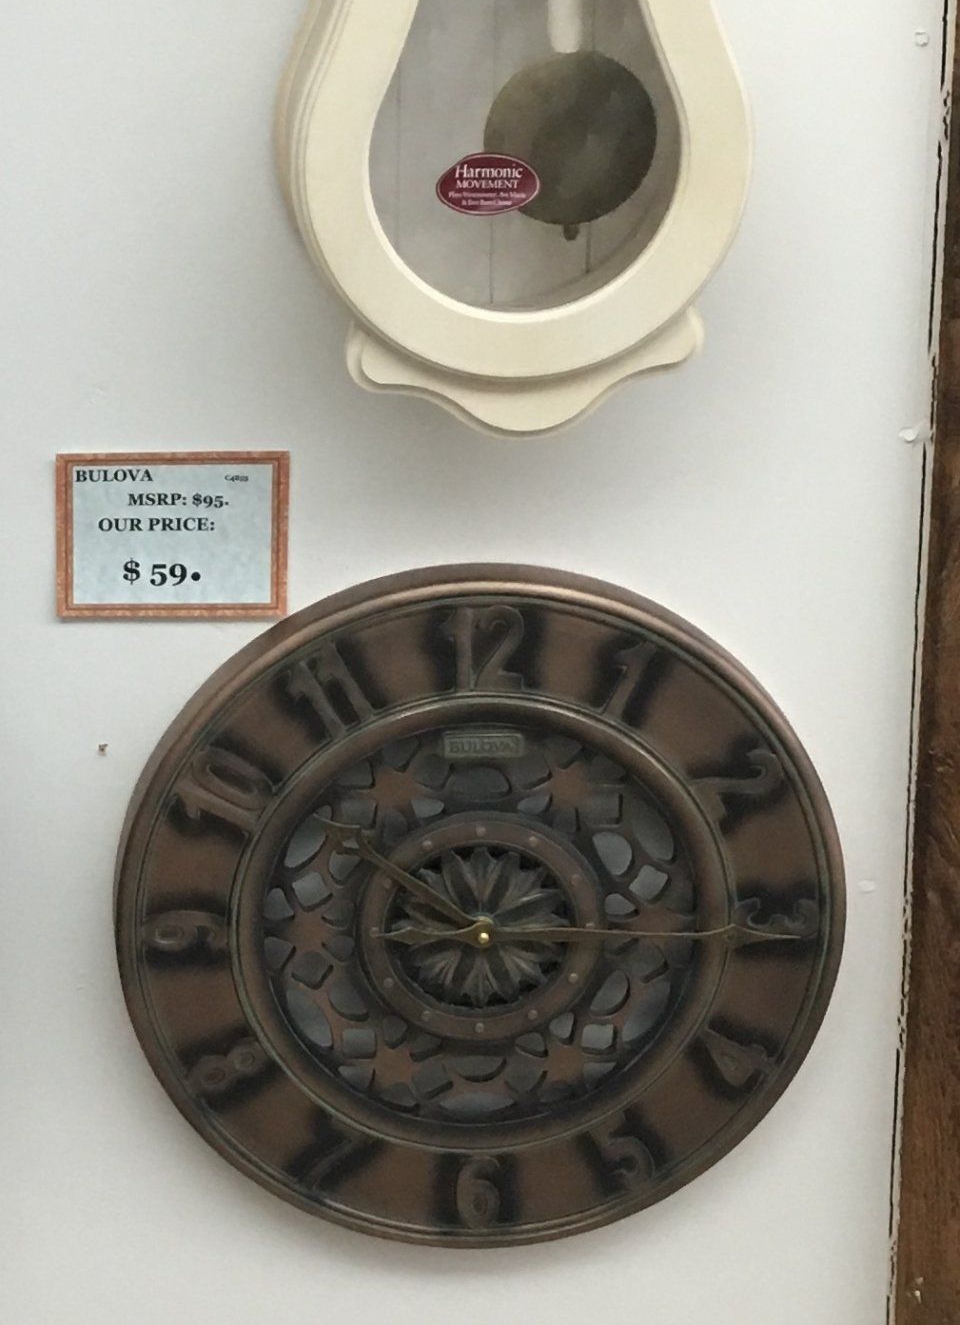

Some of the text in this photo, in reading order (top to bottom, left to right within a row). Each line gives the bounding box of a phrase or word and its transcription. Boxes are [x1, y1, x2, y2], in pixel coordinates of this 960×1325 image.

[455, 163, 523, 178] Harmonic
[456, 179, 519, 189] MOVEMENT
[75, 468, 153, 482] BULOVA
[128, 492, 229, 509] MSRP: $95.
[98, 517, 215, 532] OUR PRICE:
[122, 557, 140, 585] $
[440, 604, 528, 692] 12
[286, 641, 380, 737] 11
[596, 640, 660, 725] 1
[447, 737, 518, 754] BULOVA
[172, 746, 280, 837] 10
[687, 748, 786, 825] 2
[142, 909, 230, 954] 9
[732, 897, 822, 943] 3
[184, 1035, 275, 1093] 8
[456, 1156, 501, 1232] 6
